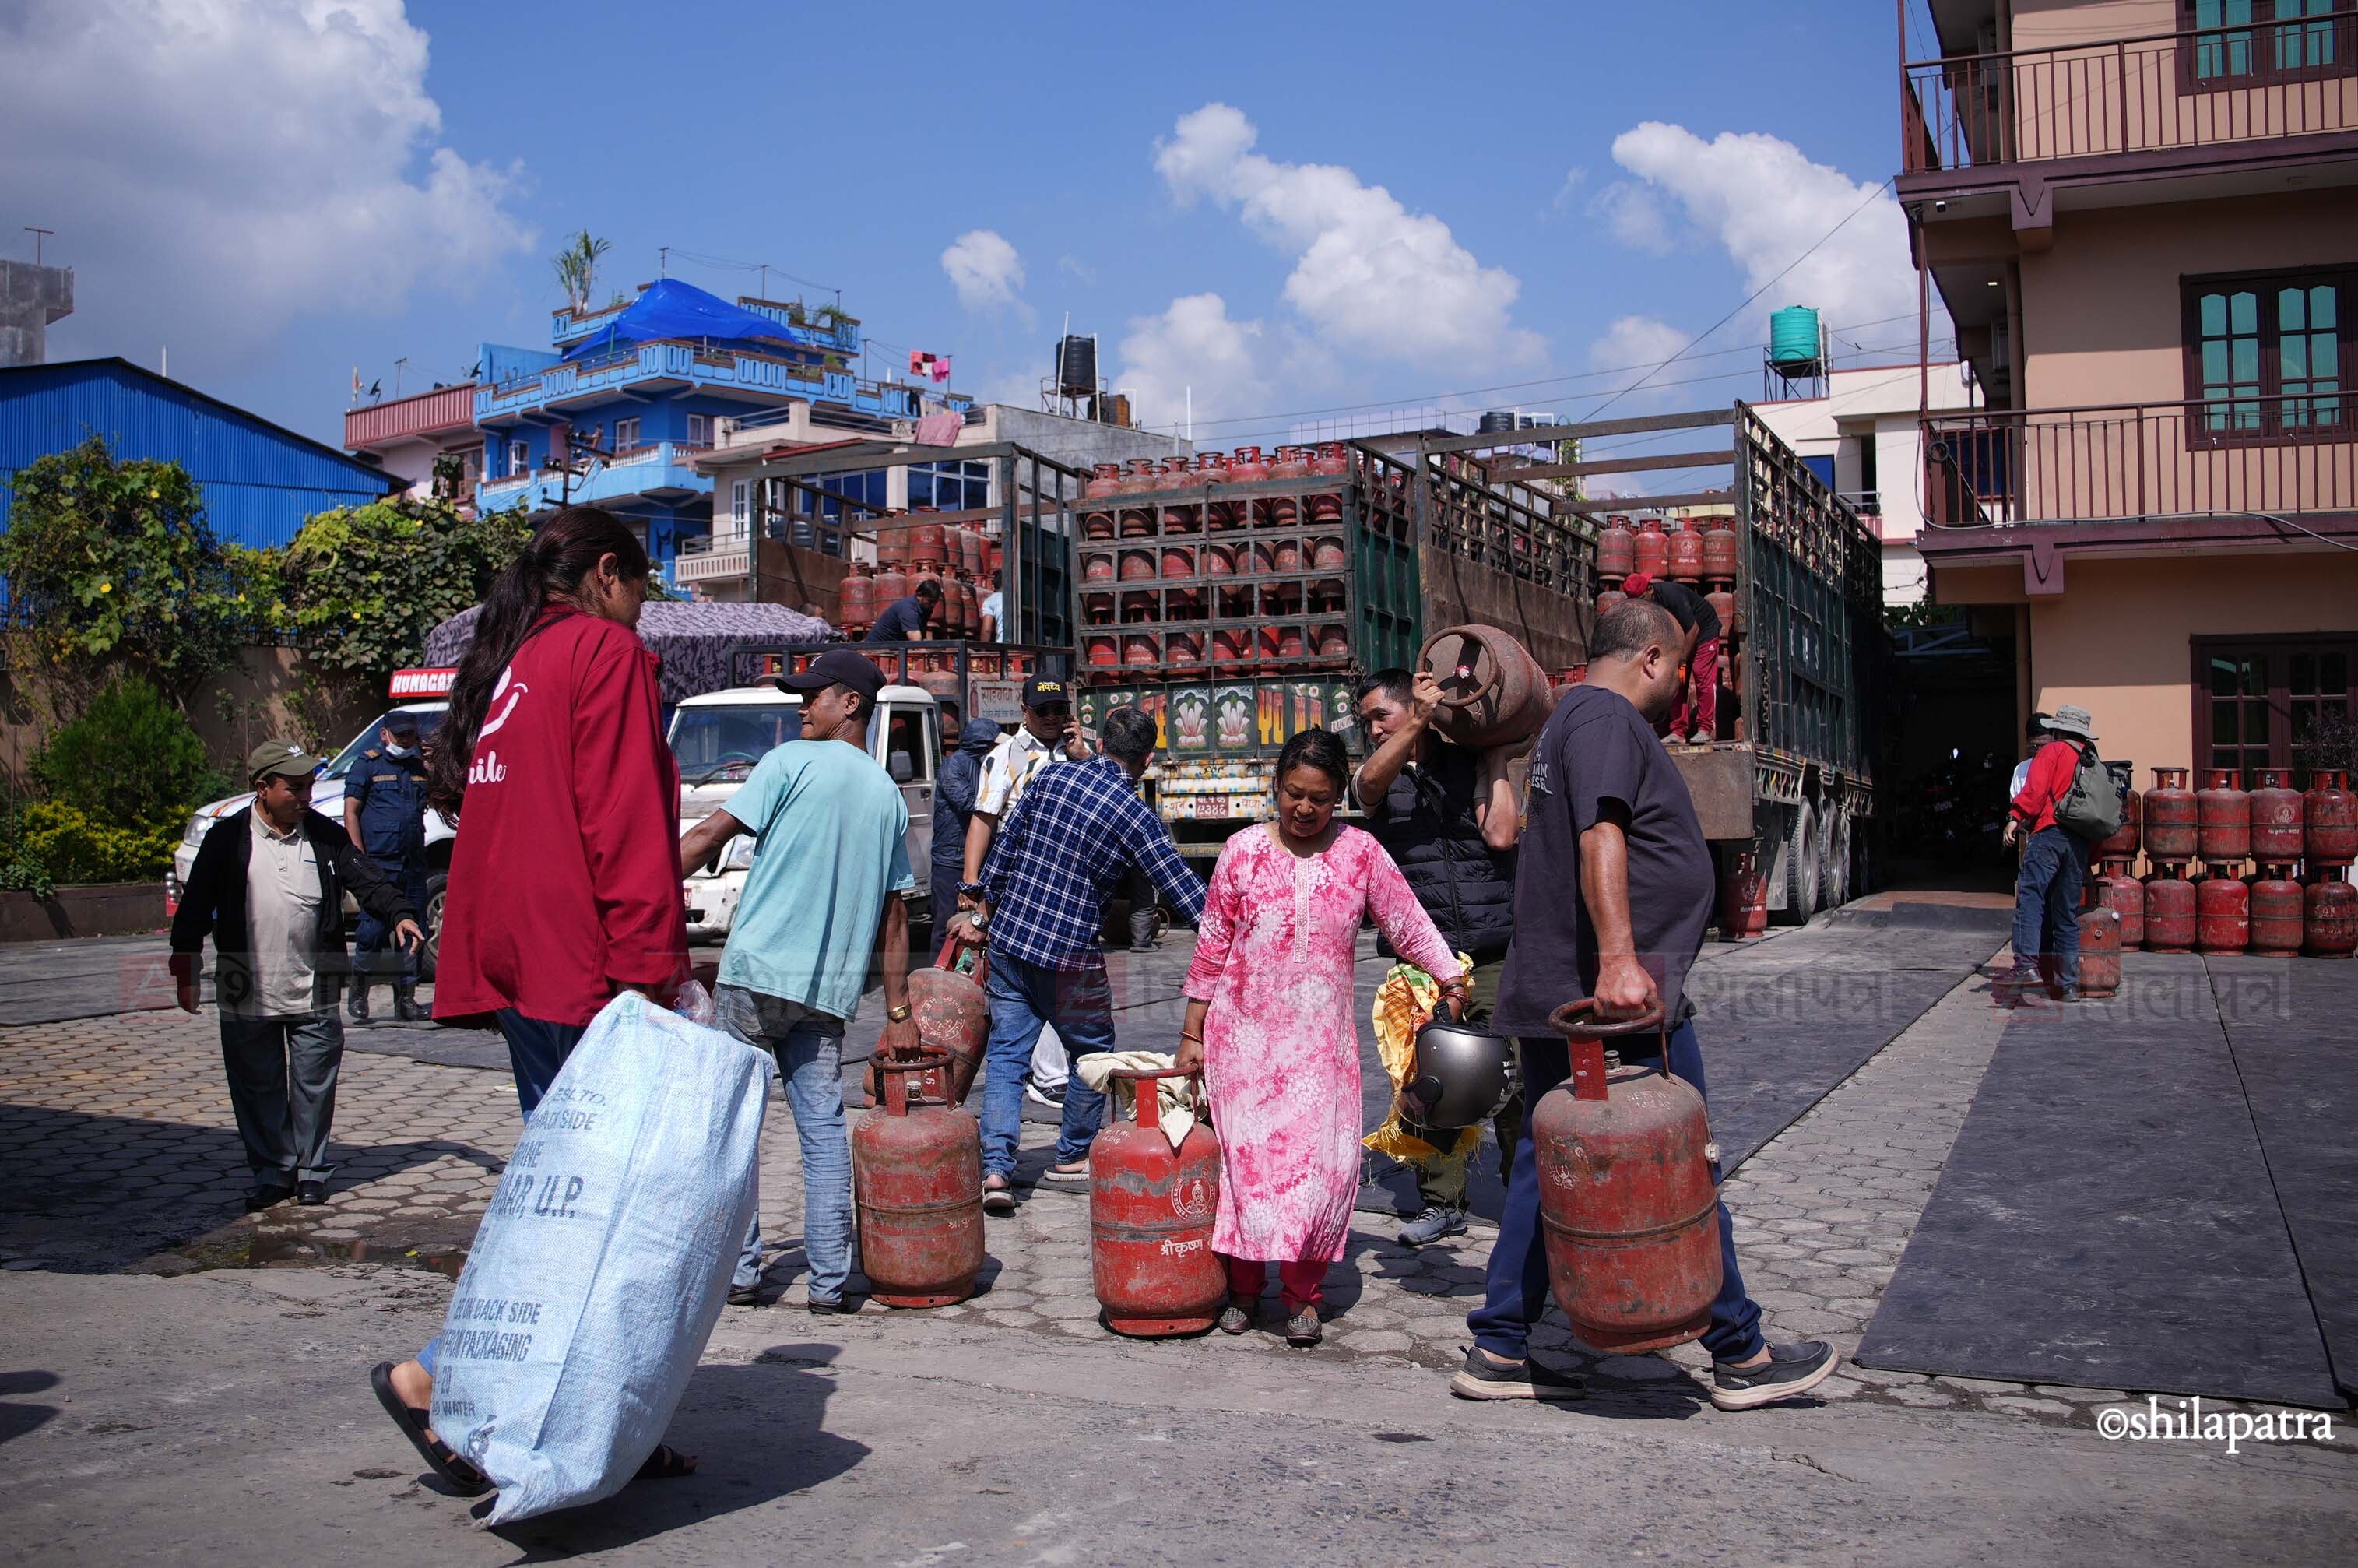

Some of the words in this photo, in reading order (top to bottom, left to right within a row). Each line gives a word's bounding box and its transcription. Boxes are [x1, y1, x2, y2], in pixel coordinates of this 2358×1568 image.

[1083, 730, 1096, 739] OOD
[469, 751, 507, 784] ile
[560, 1110, 597, 1130] SIDE
[535, 1174, 584, 1218] U.P.
[472, 1297, 508, 1322] BACK
[508, 1301, 543, 1325] SIDE
[462, 1329, 532, 1362] PACKAGING
[442, 1401, 476, 1416] WATER
